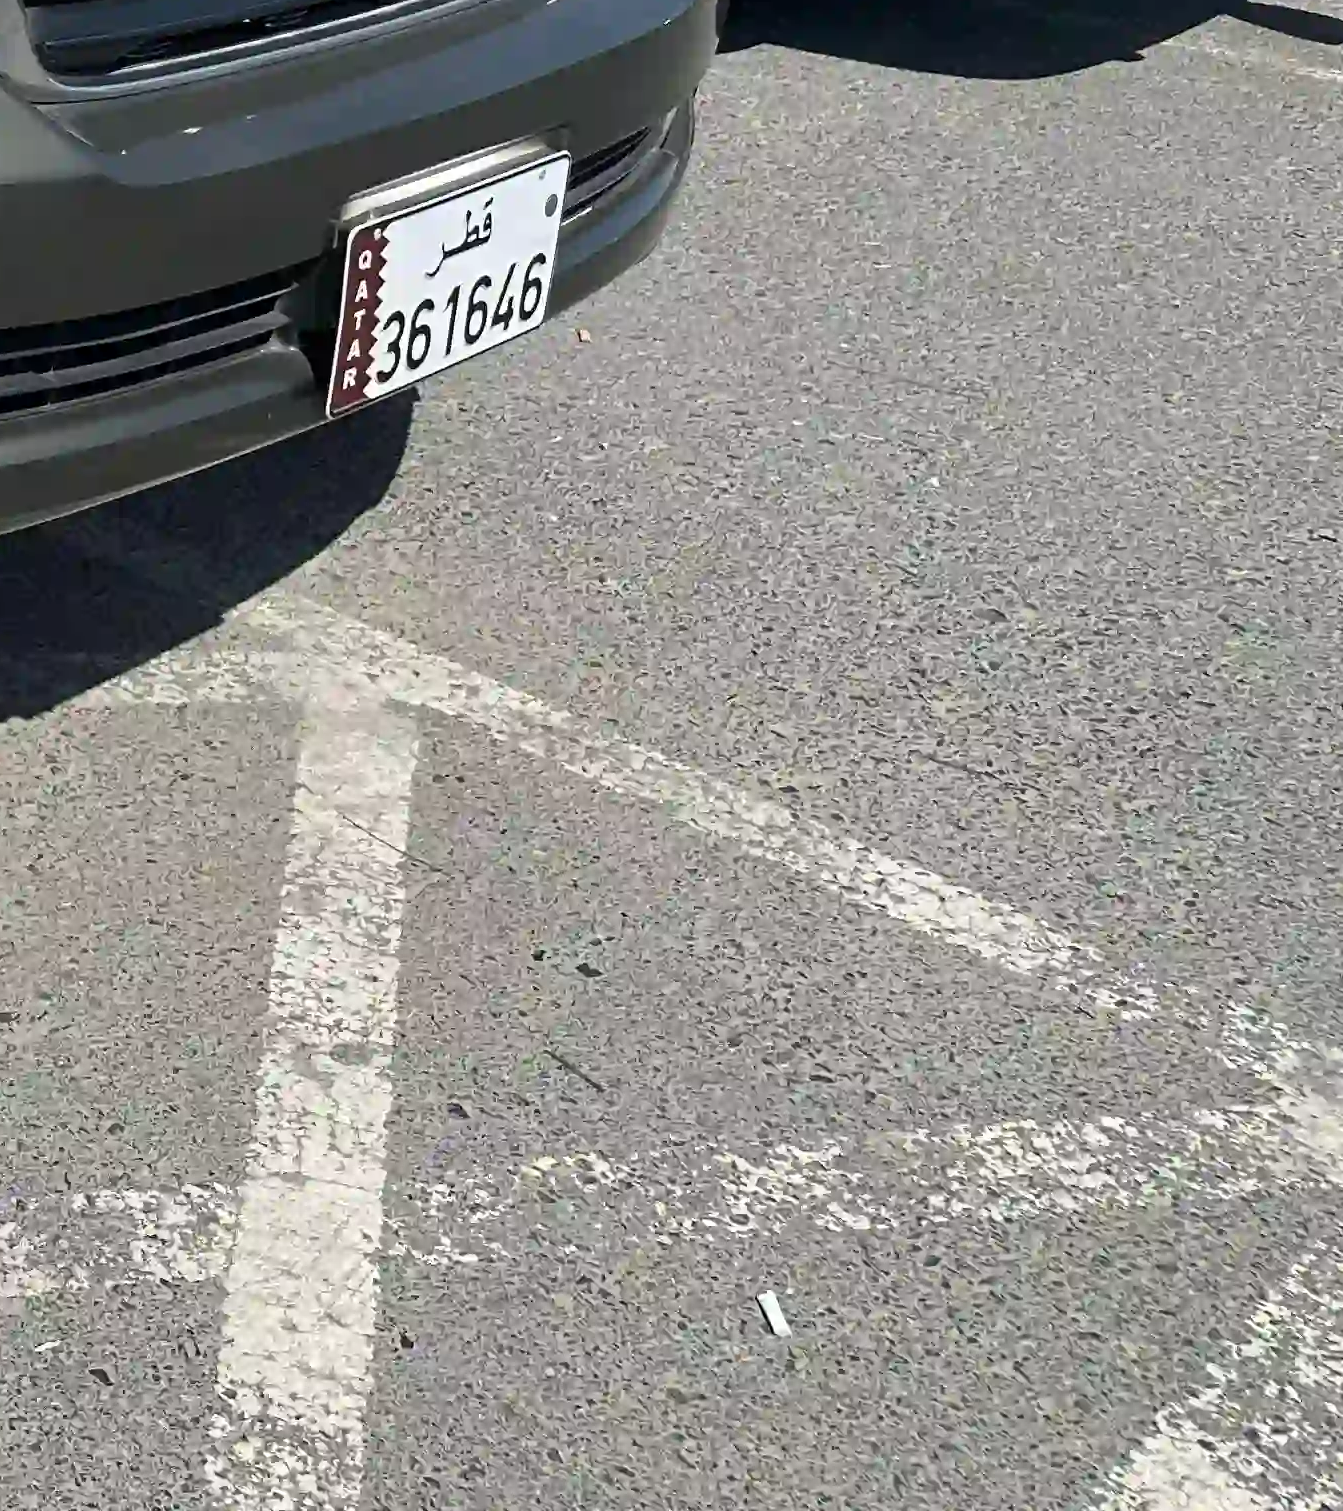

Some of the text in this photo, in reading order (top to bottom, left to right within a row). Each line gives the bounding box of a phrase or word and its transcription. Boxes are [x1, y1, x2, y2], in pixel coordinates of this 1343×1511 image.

[425, 196, 494, 279] قطر
[342, 248, 373, 390] QATAR
[374, 251, 547, 385] 361646
